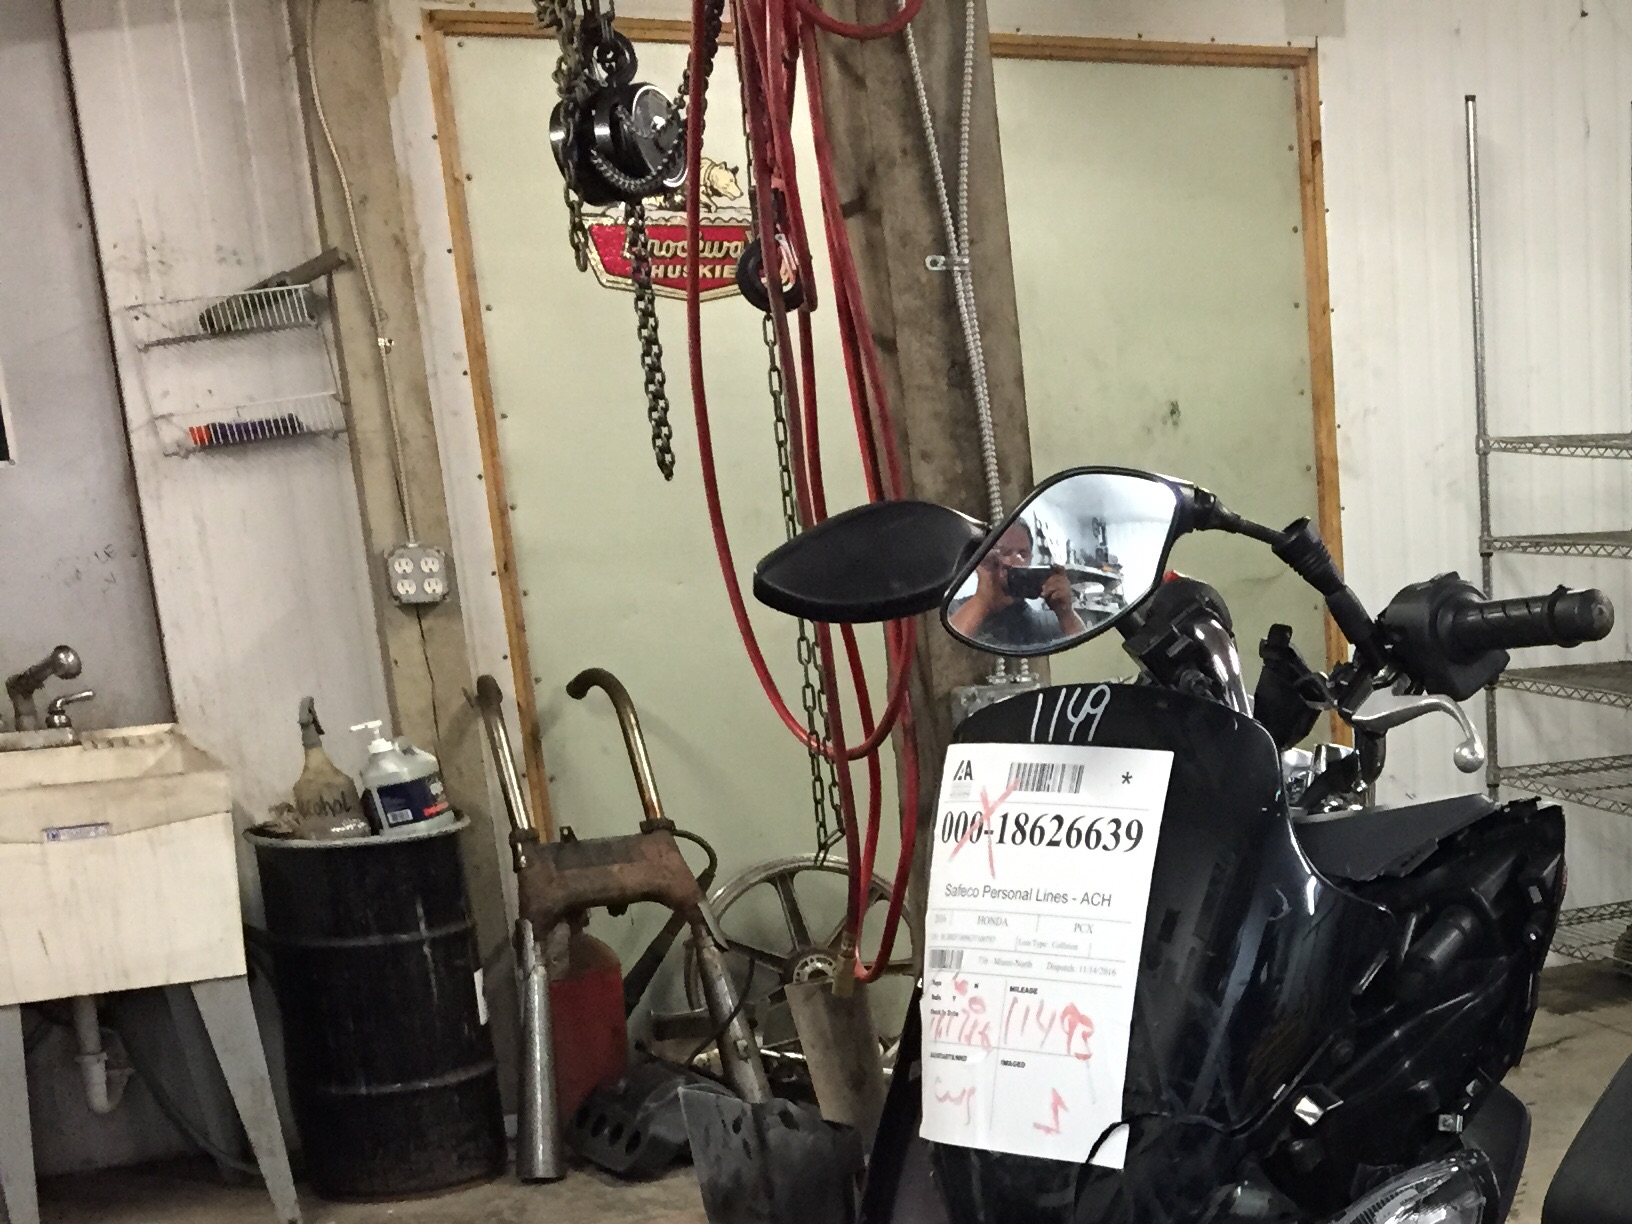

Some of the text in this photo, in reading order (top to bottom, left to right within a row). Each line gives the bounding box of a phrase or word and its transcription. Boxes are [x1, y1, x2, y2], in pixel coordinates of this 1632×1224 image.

[1030, 684, 1111, 742] 1149
[941, 810, 1144, 853] 000-18626639
[944, 883, 980, 899] Safeco
[982, 884, 1033, 901] Personal
[1035, 888, 1069, 904] Lines
[1080, 893, 1112, 907] ACH
[977, 915, 1009, 927] HONDA
[1073, 922, 1094, 935] PCX
[1009, 986, 1039, 995] MILEAGE
